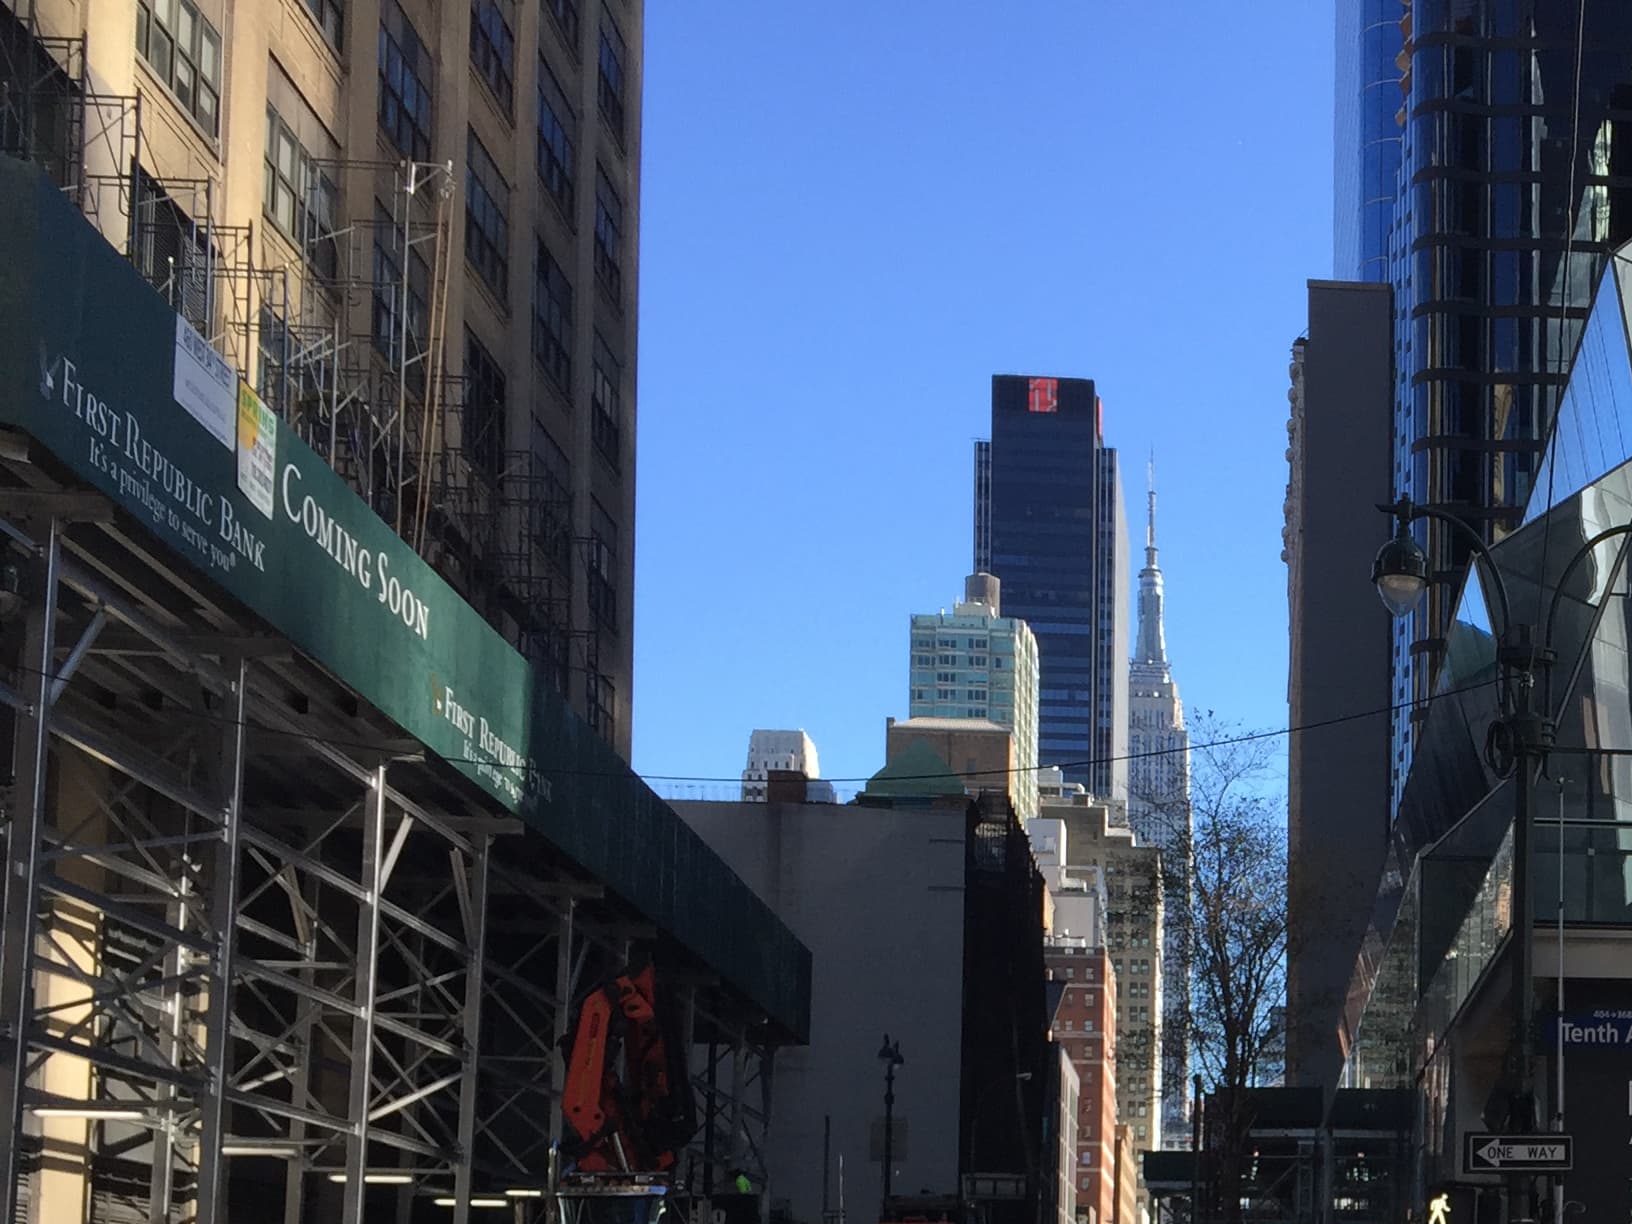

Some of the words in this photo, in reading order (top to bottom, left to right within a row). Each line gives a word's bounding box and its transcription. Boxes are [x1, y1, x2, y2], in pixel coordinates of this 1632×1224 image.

[63, 357, 120, 447] FIRST
[125, 411, 213, 526] REPUBLIC
[219, 495, 265, 572] BANK
[120, 467, 166, 523] privilege
[168, 509, 180, 531] to
[282, 464, 371, 588] COMING
[378, 552, 429, 640] SOON
[1563, 1022, 1619, 1043] Tenth
[1488, 1146, 1513, 1159] ONE
[1528, 1146, 1557, 1159] WAY
